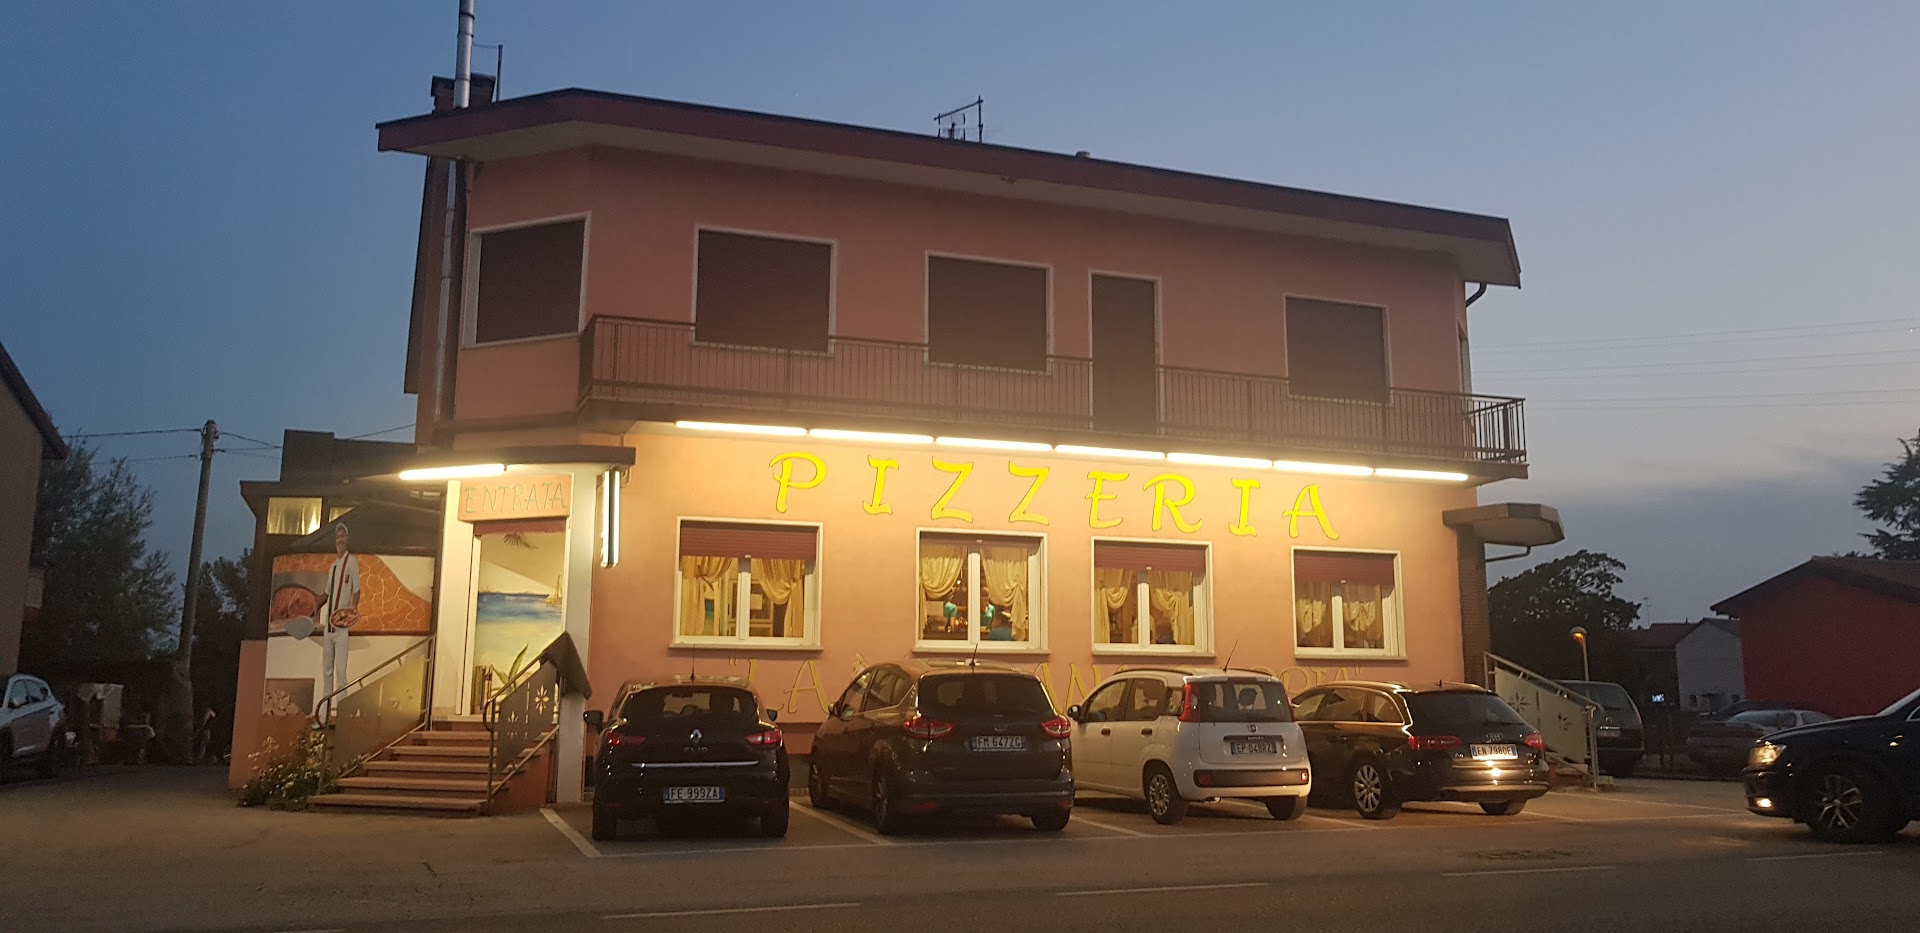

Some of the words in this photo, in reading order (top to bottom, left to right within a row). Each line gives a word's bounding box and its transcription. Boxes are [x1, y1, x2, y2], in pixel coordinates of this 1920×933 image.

[465, 482, 567, 514] ENTRATA
[769, 452, 1339, 540] PIZZERIA
[1477, 746, 1488, 756] EN
[670, 787, 683, 799] FE
[687, 787, 718, 799] 999ZA
